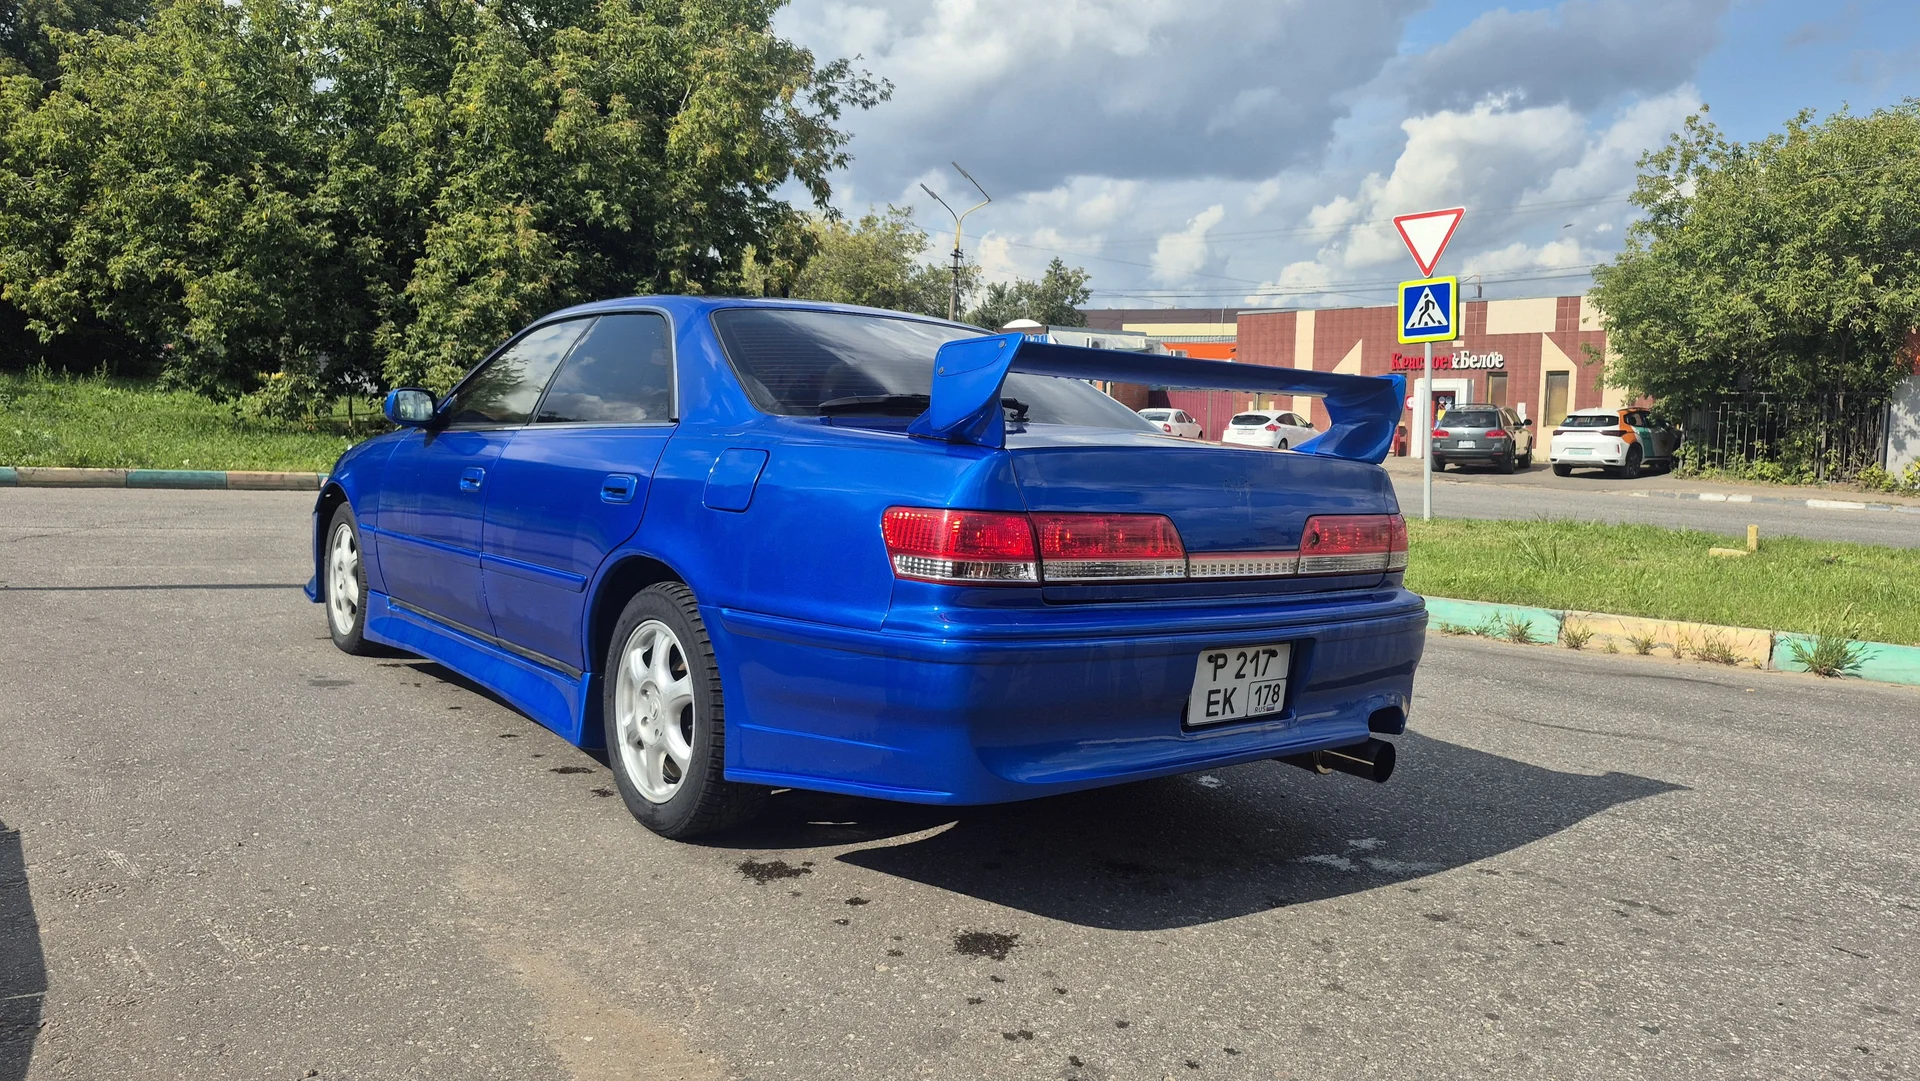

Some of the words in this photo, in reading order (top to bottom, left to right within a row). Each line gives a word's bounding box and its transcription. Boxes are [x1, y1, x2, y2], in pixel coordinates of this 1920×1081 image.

[1391, 350, 1504, 370] Красое&Белое
[1212, 652, 1228, 682] Р
[1234, 648, 1272, 680] 217
[1205, 686, 1237, 718] ЕК
[1254, 683, 1281, 707] 178
[1254, 705, 1266, 713] RUS
